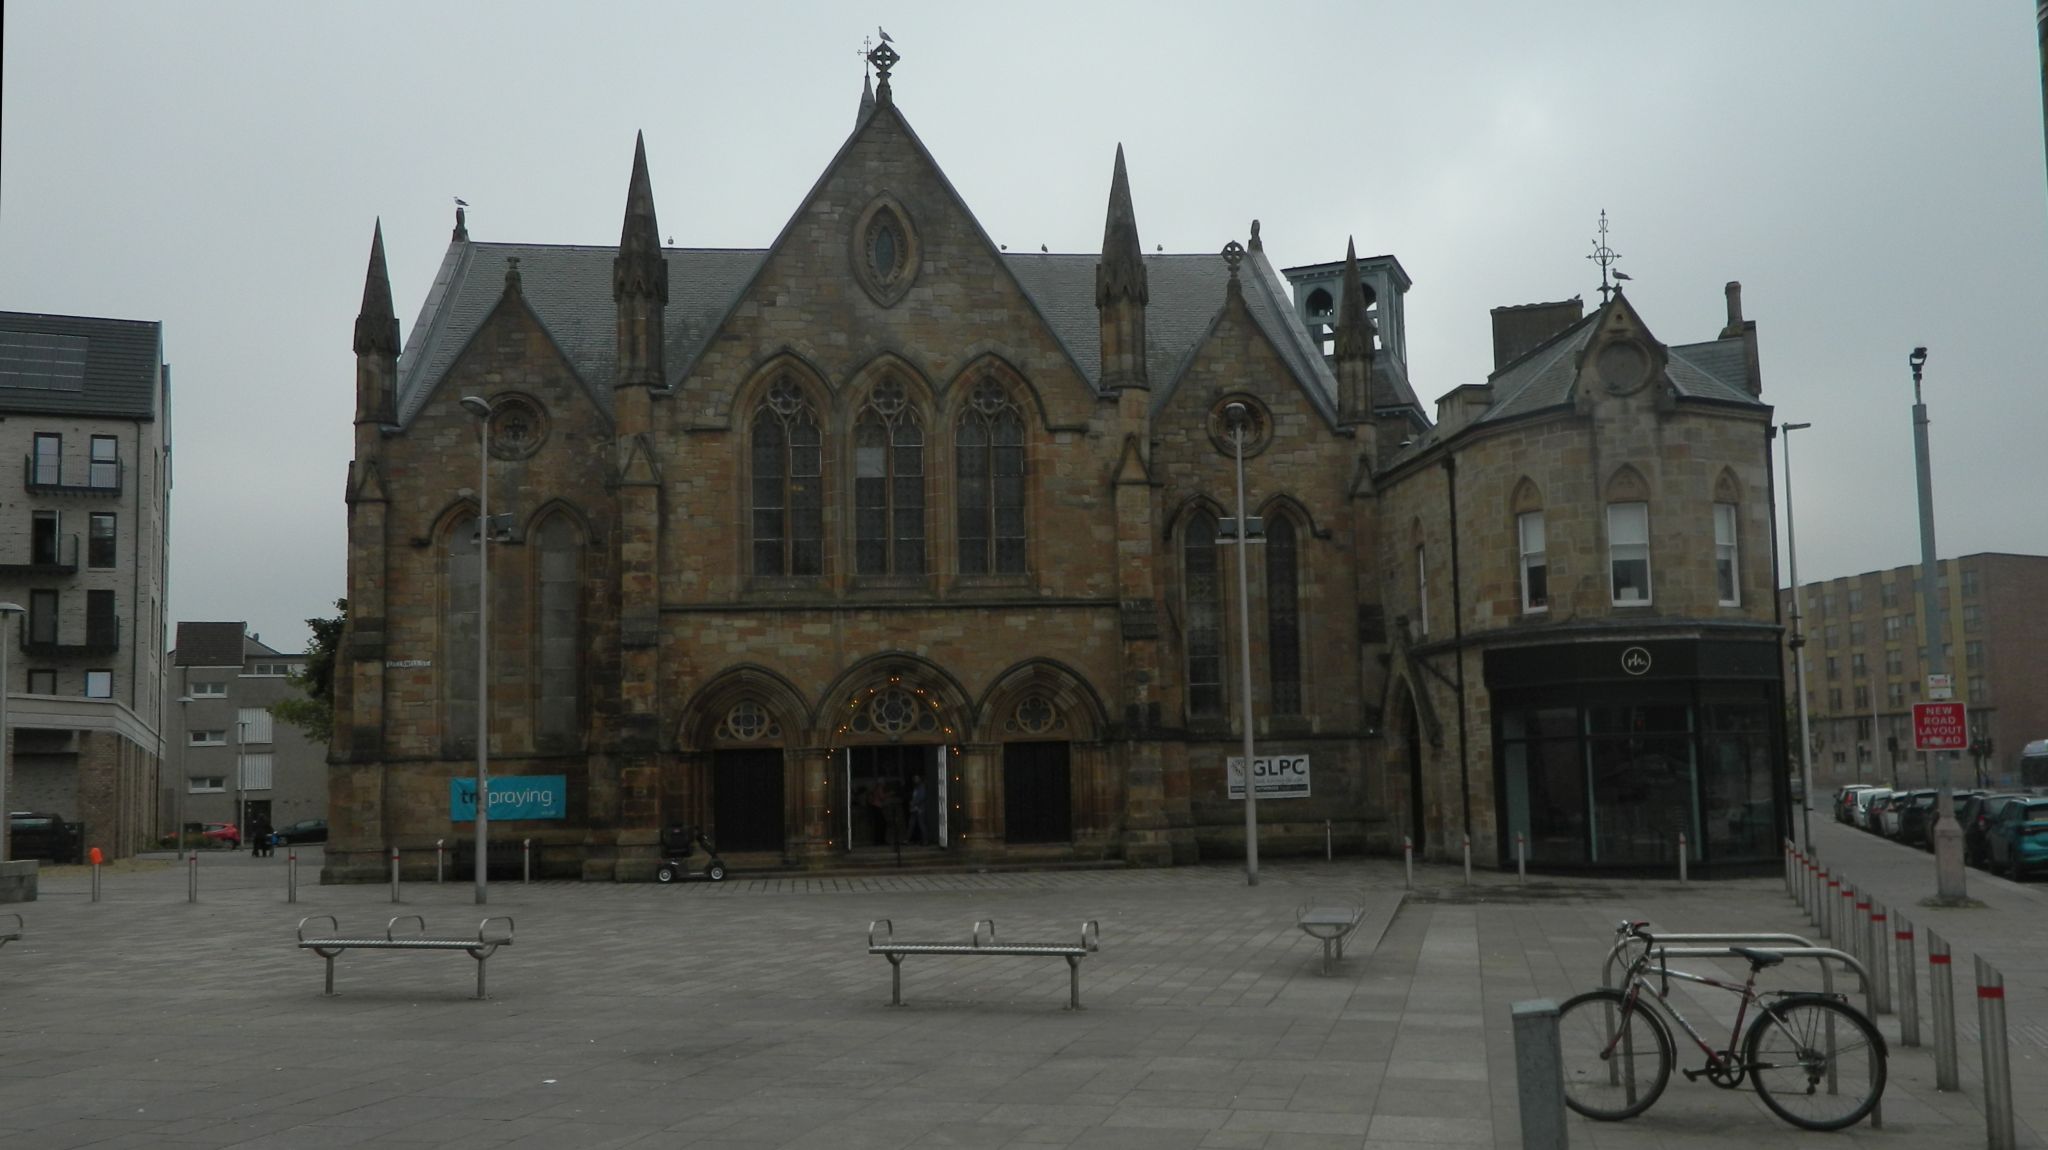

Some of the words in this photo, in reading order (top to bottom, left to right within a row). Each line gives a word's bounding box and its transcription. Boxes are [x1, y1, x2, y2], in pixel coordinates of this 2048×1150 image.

[1926, 707, 1952, 715] NEW
[1924, 717, 1956, 725] ROAD
[1919, 726, 1961, 736] LAYOUT
[1922, 736, 1961, 745] AAD
[1253, 759, 1306, 776] GLPC
